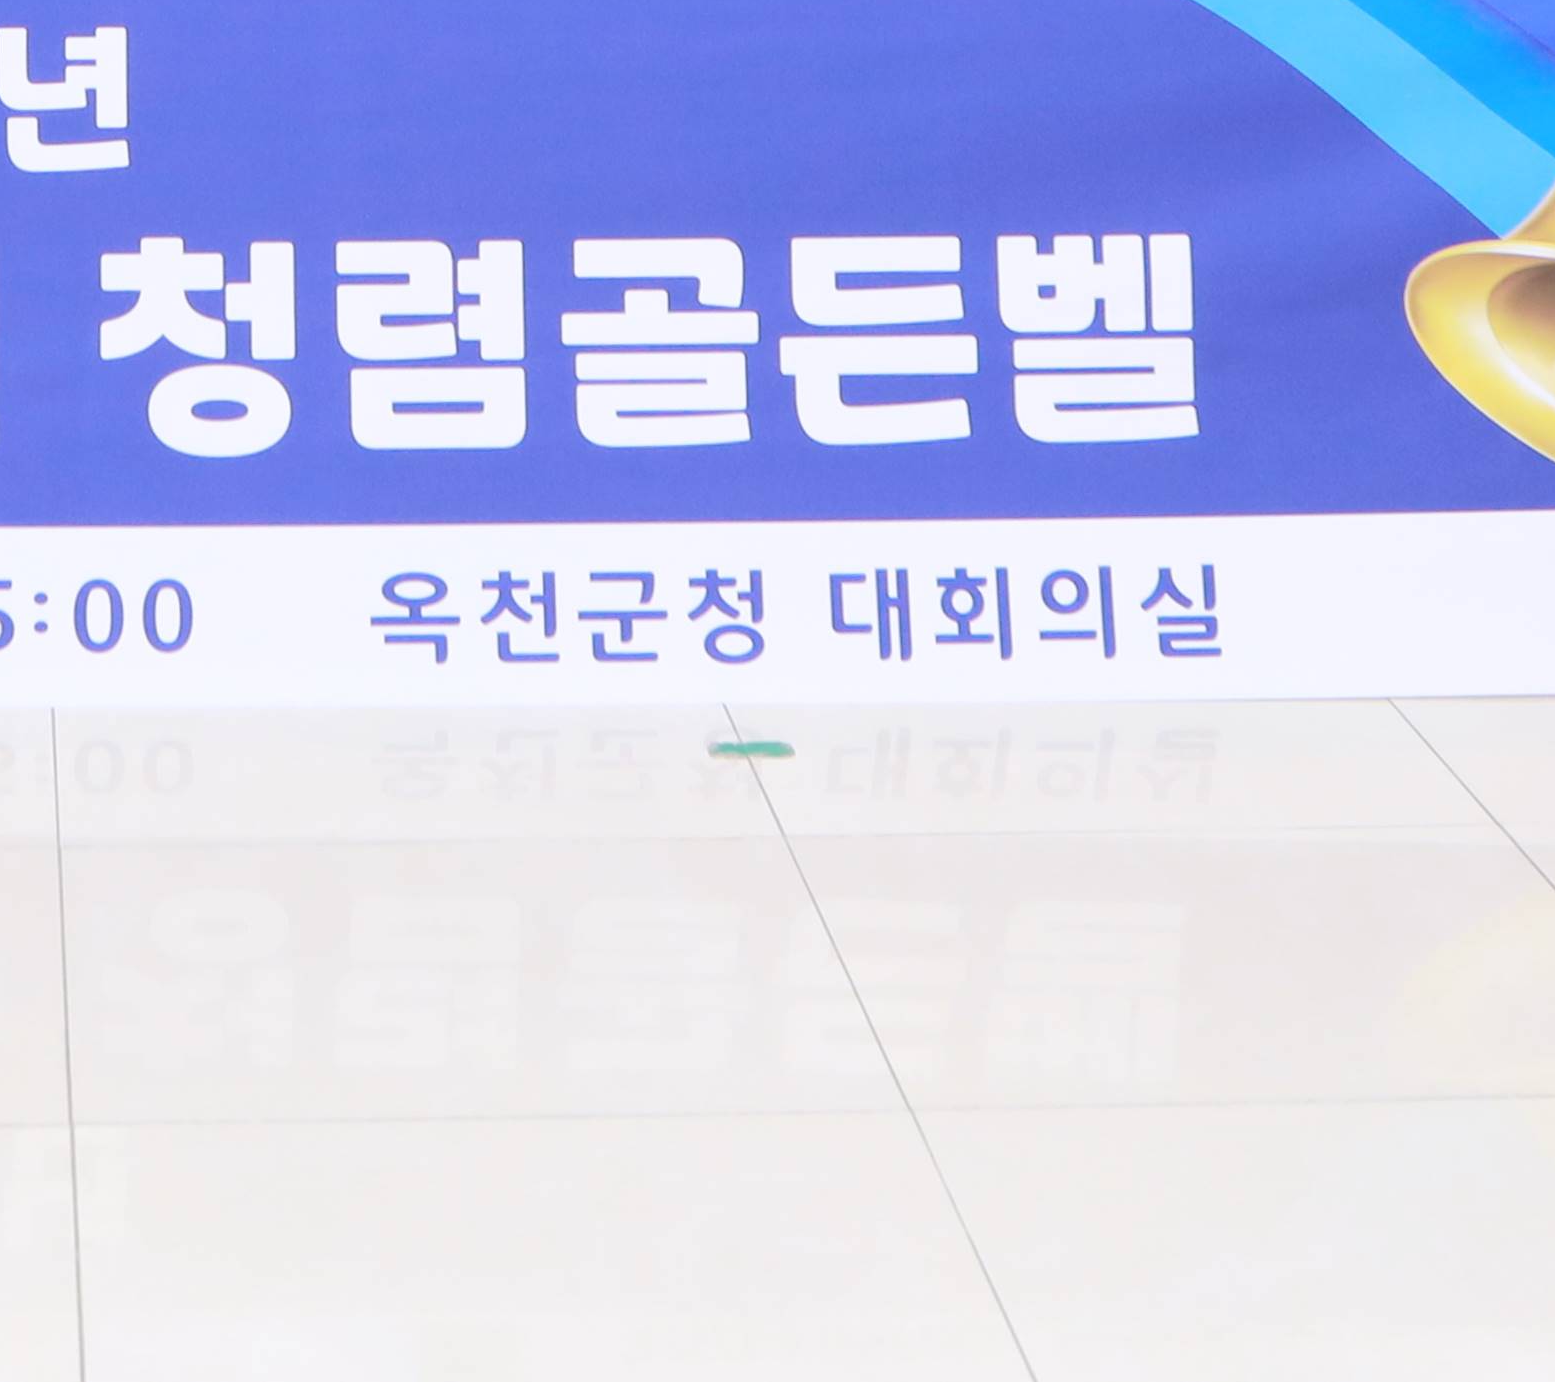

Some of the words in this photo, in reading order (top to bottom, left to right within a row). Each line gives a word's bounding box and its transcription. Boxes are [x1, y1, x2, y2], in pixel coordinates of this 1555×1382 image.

[99, 234, 1200, 458] 청렴골든벨
[370, 568, 766, 664] 옥천군청
[829, 563, 1223, 661] 대회의실
